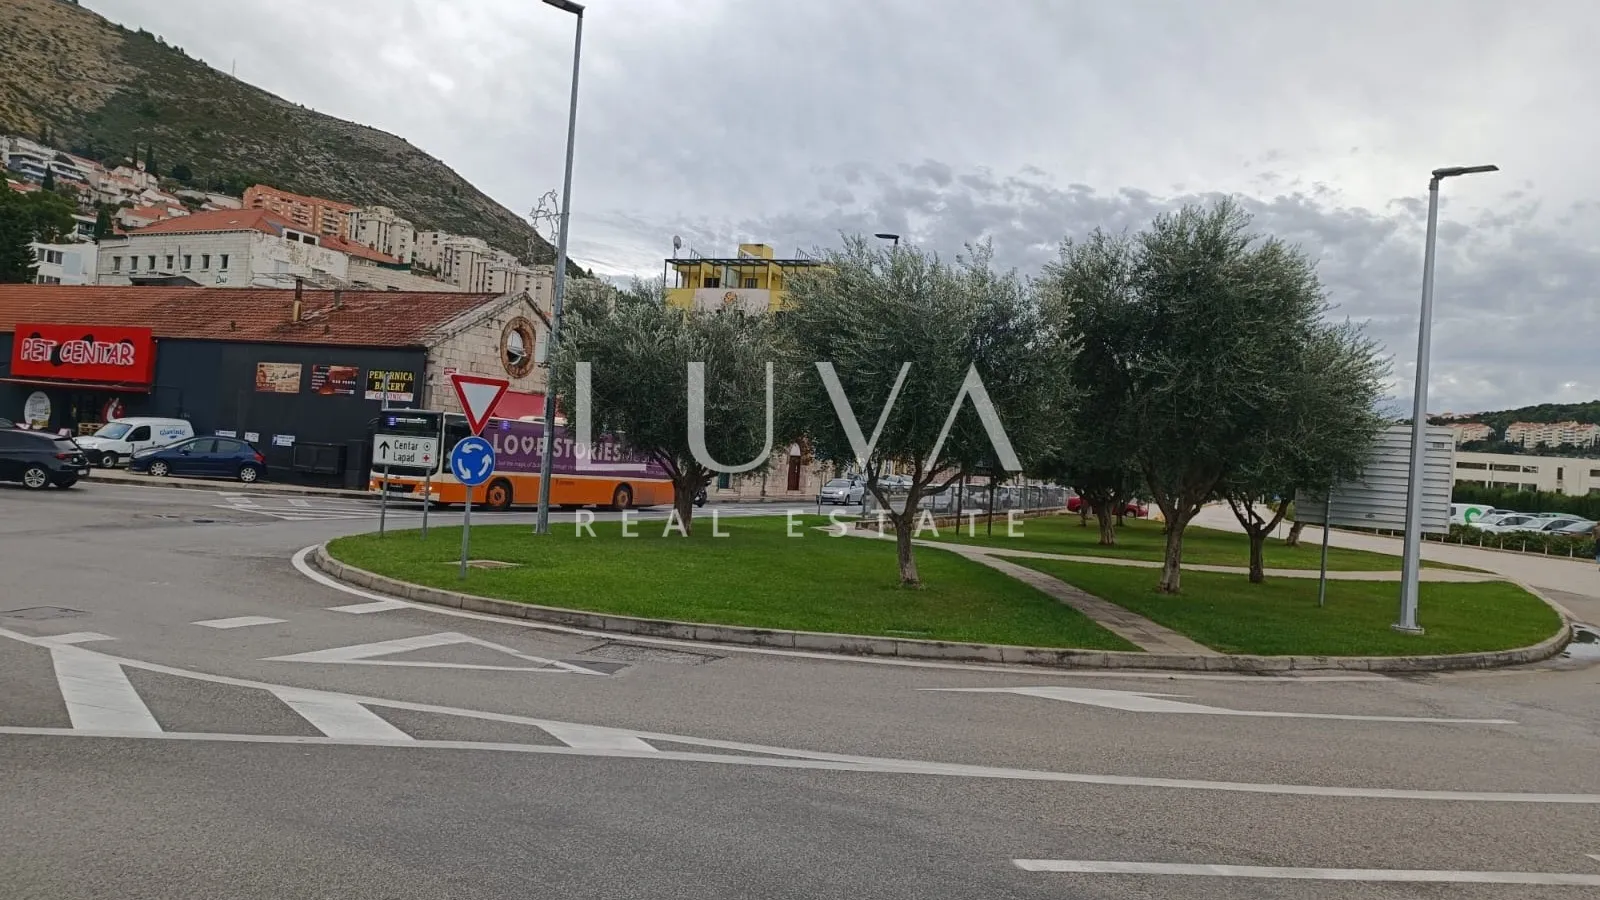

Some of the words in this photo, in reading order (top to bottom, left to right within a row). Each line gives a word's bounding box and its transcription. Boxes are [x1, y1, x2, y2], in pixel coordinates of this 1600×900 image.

[21, 337, 58, 362] PET
[59, 339, 136, 366] CENTAR
[394, 440, 418, 451] Centar
[393, 452, 415, 463] Lapad
